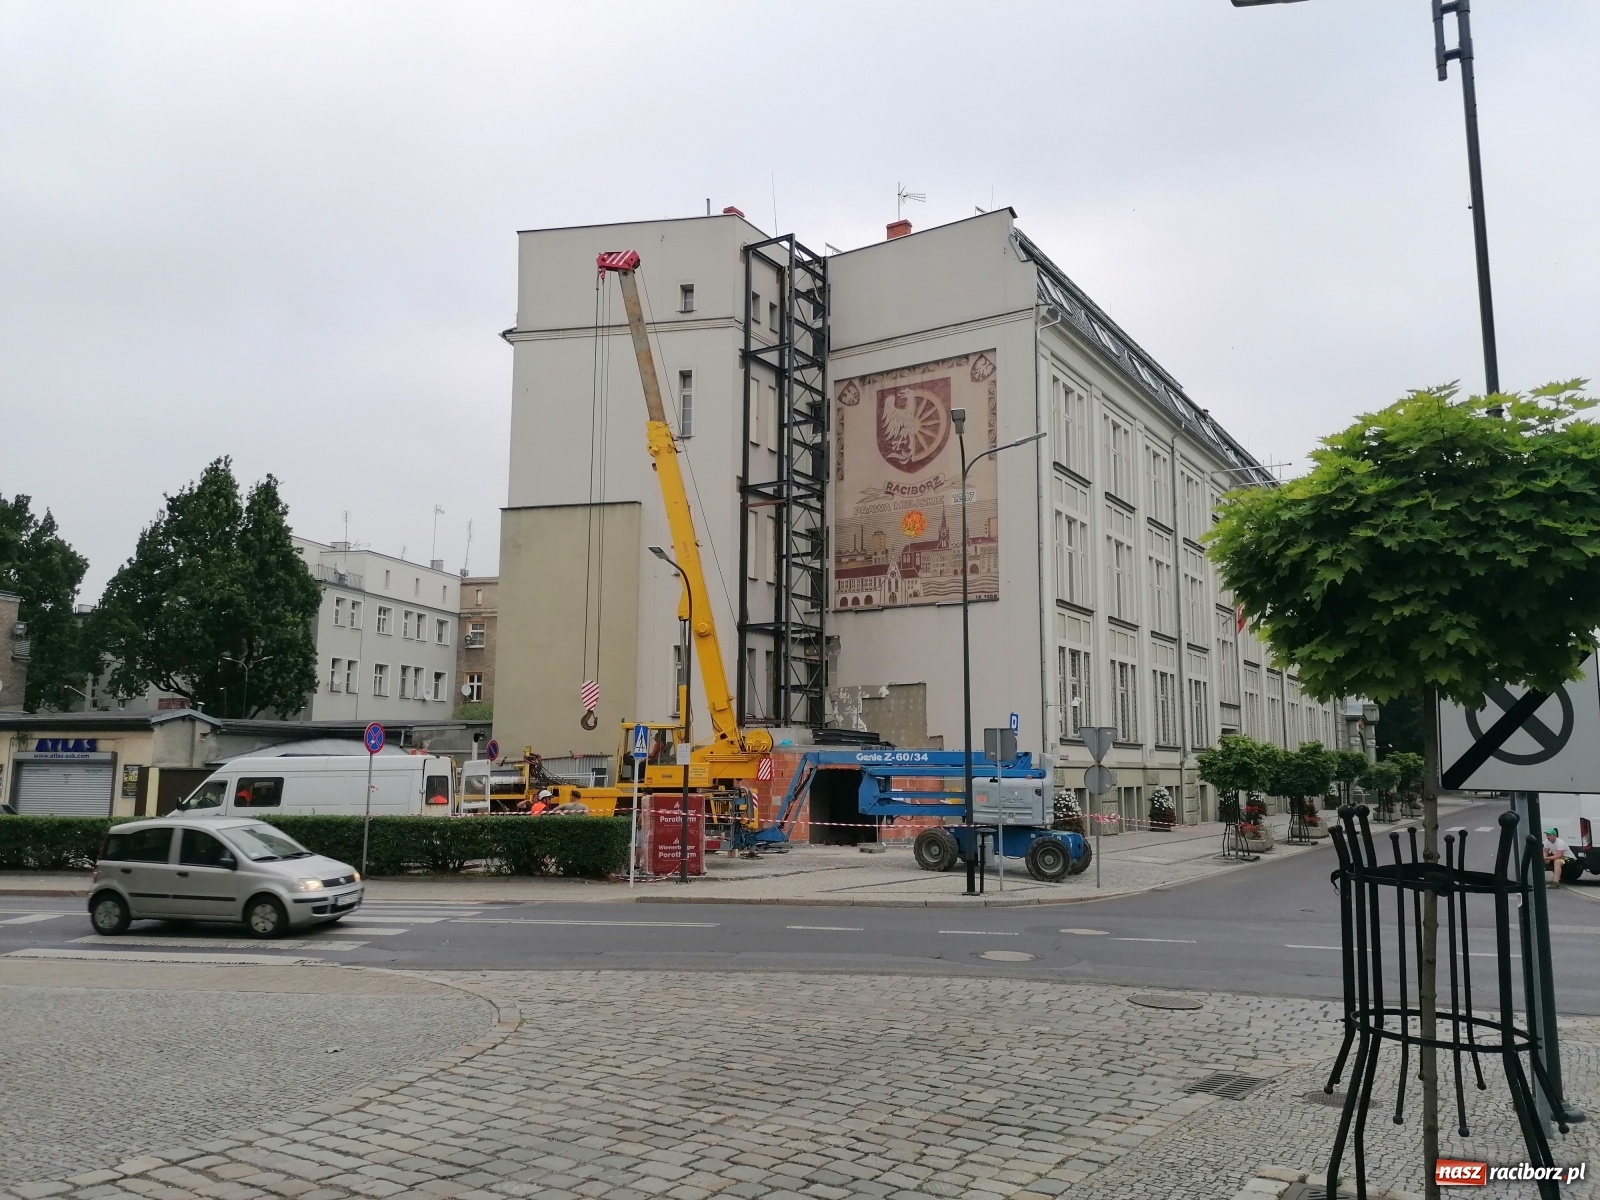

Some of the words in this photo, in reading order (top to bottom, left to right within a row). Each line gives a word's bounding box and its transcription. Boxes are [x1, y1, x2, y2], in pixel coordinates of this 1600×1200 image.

[853, 503, 892, 516] PRAWA
[894, 495, 945, 511] MIEJSKIE
[35, 738, 98, 752] ATLAS
[856, 752, 882, 761] Genie
[884, 752, 929, 762] Z-60/34
